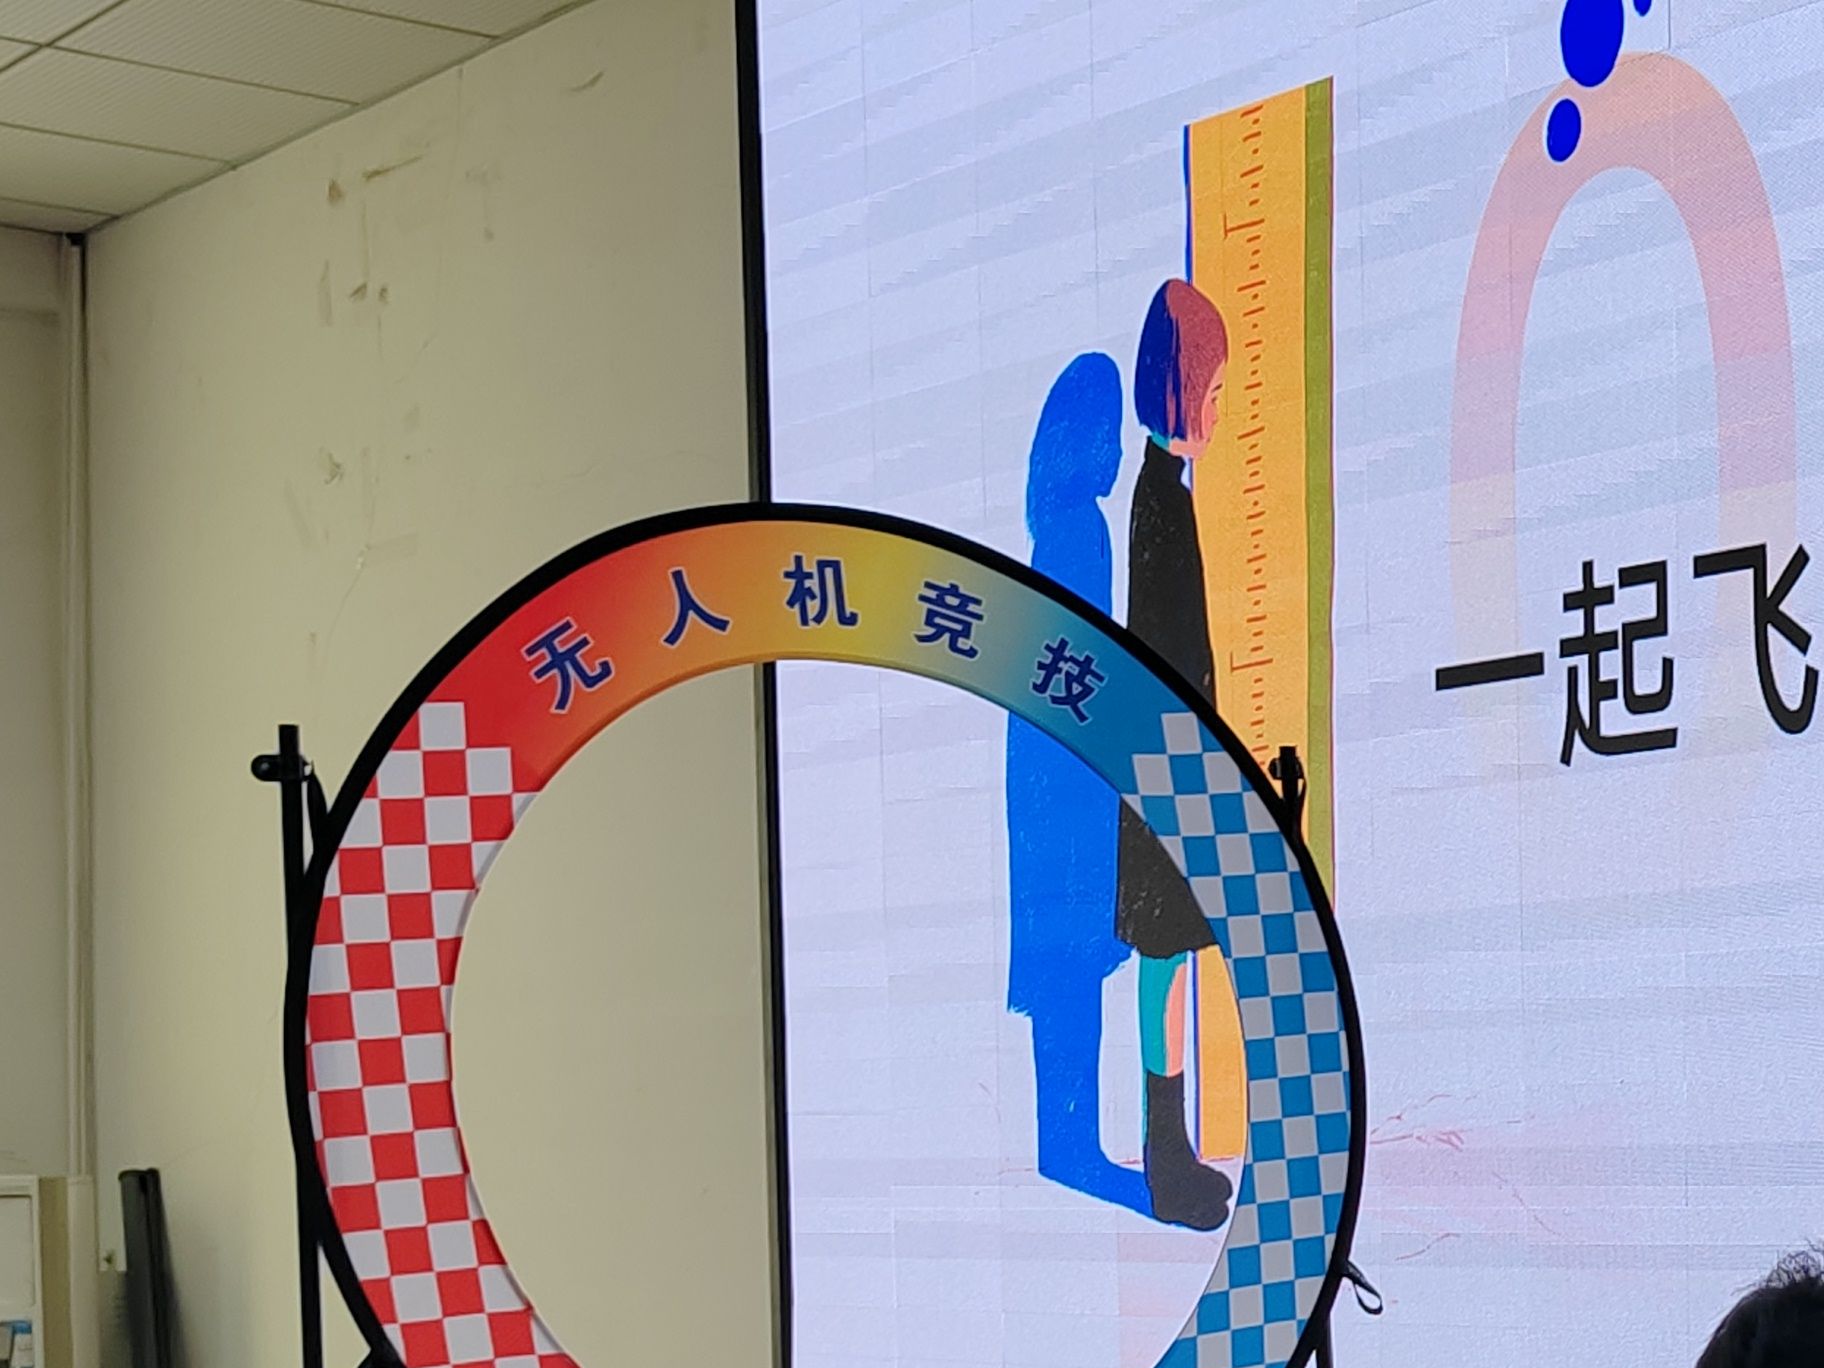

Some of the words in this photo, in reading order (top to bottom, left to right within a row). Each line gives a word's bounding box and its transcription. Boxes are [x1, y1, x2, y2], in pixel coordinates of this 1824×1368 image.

[523, 554, 1108, 724] 无人机竞技
